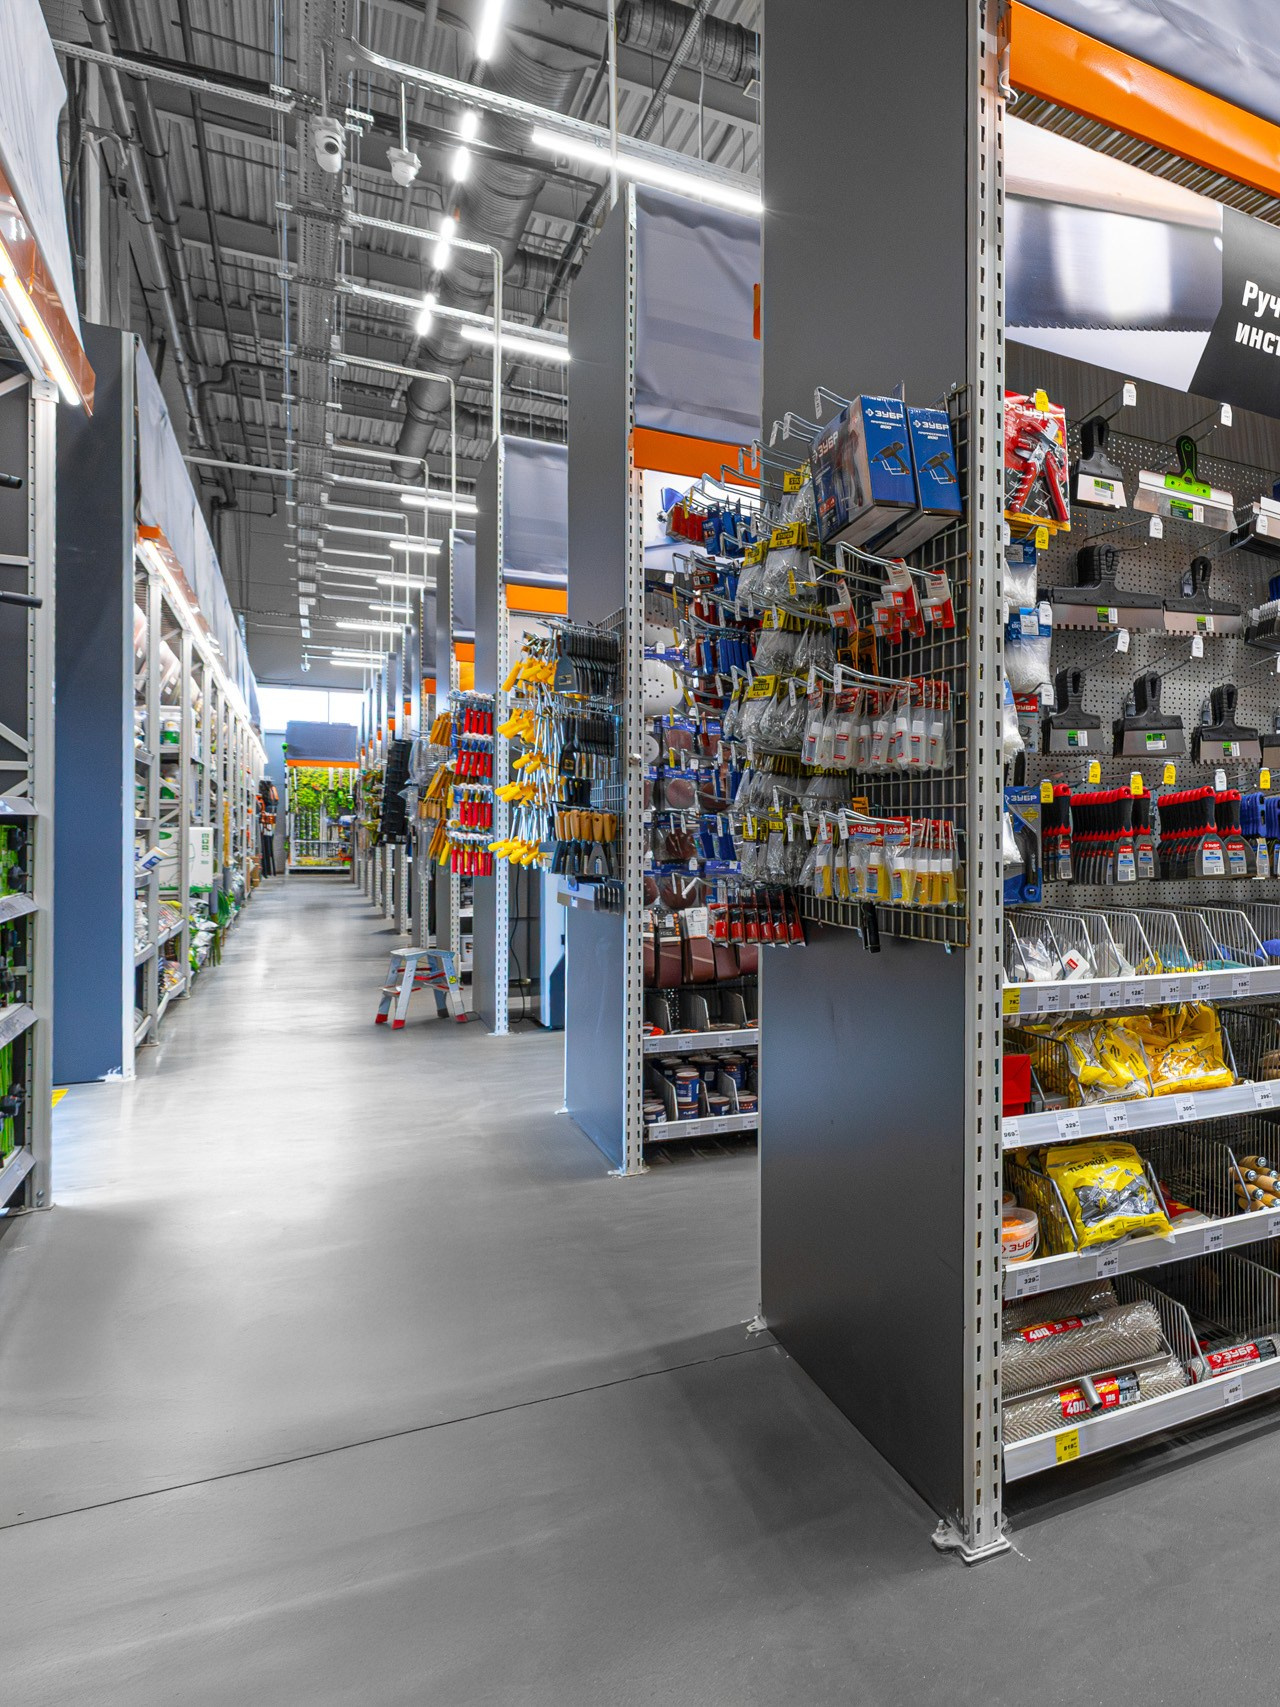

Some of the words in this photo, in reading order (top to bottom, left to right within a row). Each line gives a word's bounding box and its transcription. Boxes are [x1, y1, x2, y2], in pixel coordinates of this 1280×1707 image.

[874, 409, 904, 420] ЗУБР
[922, 421, 950, 430] ЗУБР
[817, 430, 839, 458] ЗУБР
[1010, 794, 1038, 802] ЗУБР
[861, 826, 881, 834] ЗУБР
[1067, 1155, 1109, 1173] TLS-PROFI
[1009, 1233, 1036, 1252] ЗУБР
[1023, 1277, 1036, 1285] 329
[1029, 1327, 1050, 1340] 400
[1223, 1345, 1255, 1360] ЗУБР
[1066, 1400, 1086, 1415] 400
